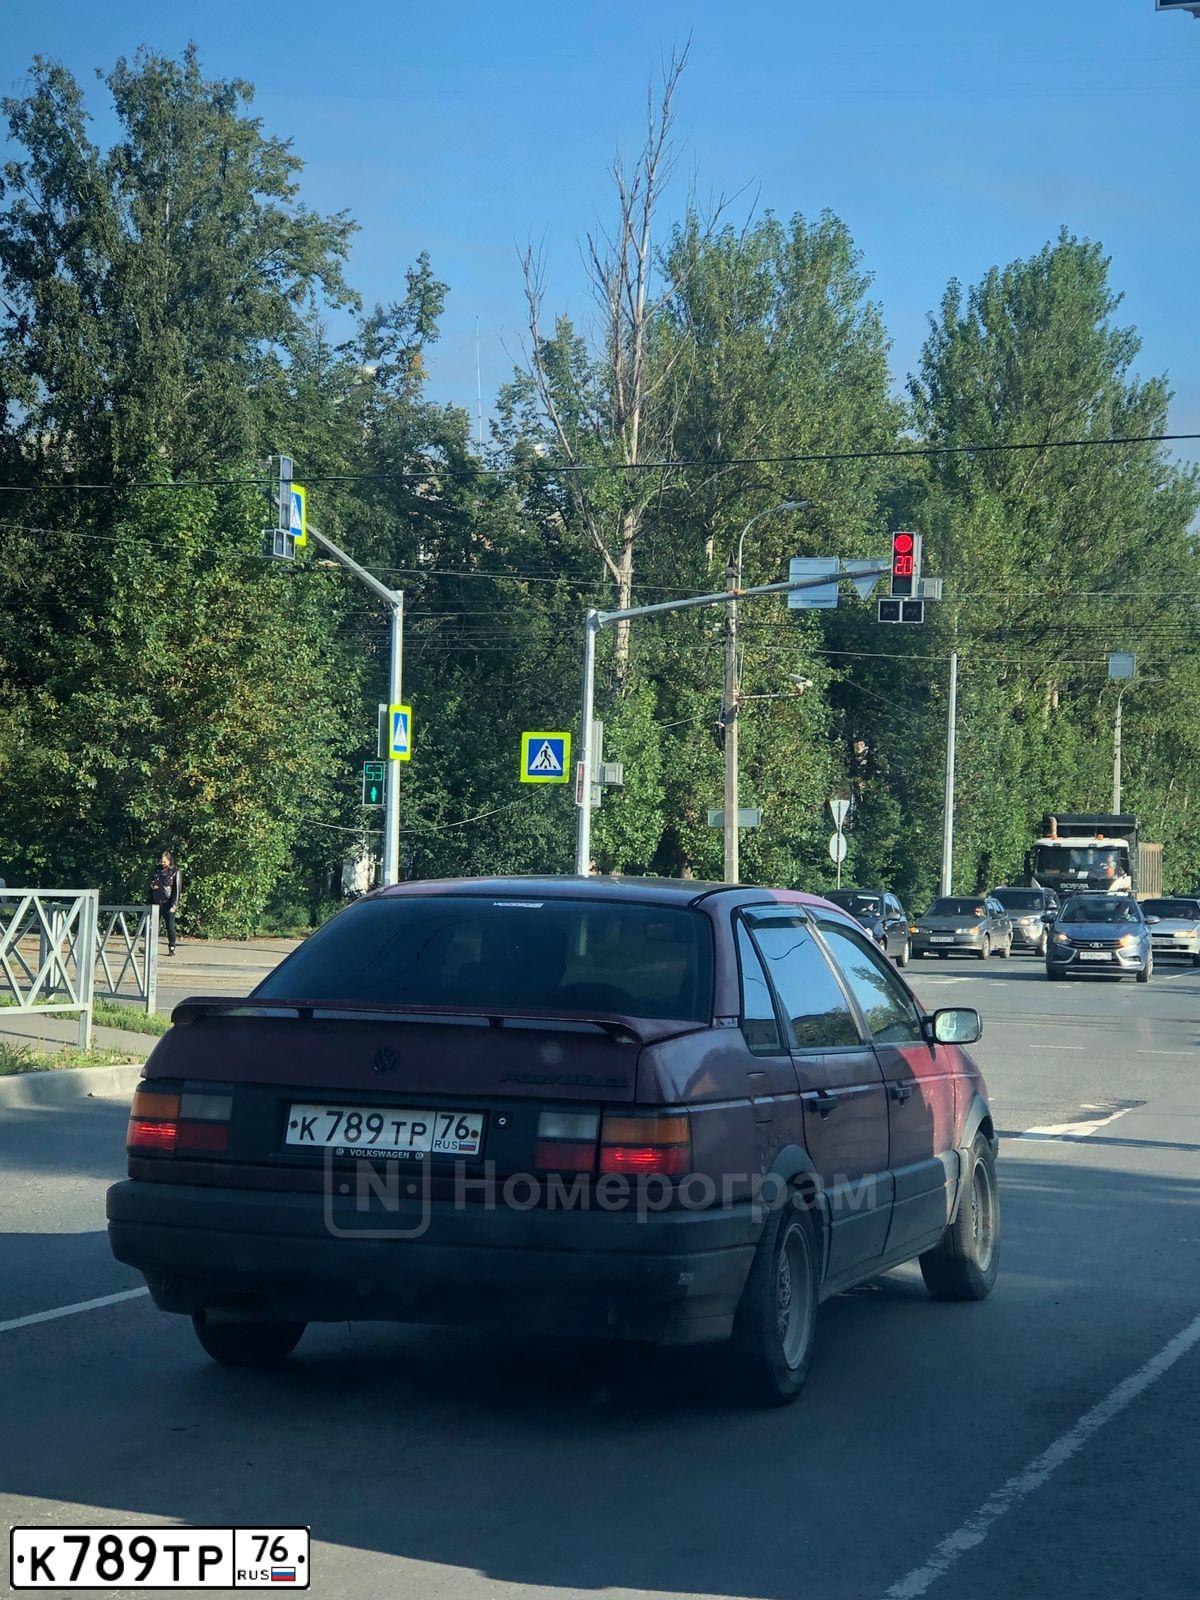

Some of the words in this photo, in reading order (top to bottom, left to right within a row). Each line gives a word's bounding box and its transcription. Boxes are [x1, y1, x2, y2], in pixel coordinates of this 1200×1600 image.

[894, 555, 913, 575] 20
[366, 764, 383, 781] 53
[299, 1110, 427, 1146] К789ТР
[440, 1114, 469, 1140] 76
[434, 1139, 458, 1150] RUS
[350, 1148, 410, 1159] VOLKSWAGEN
